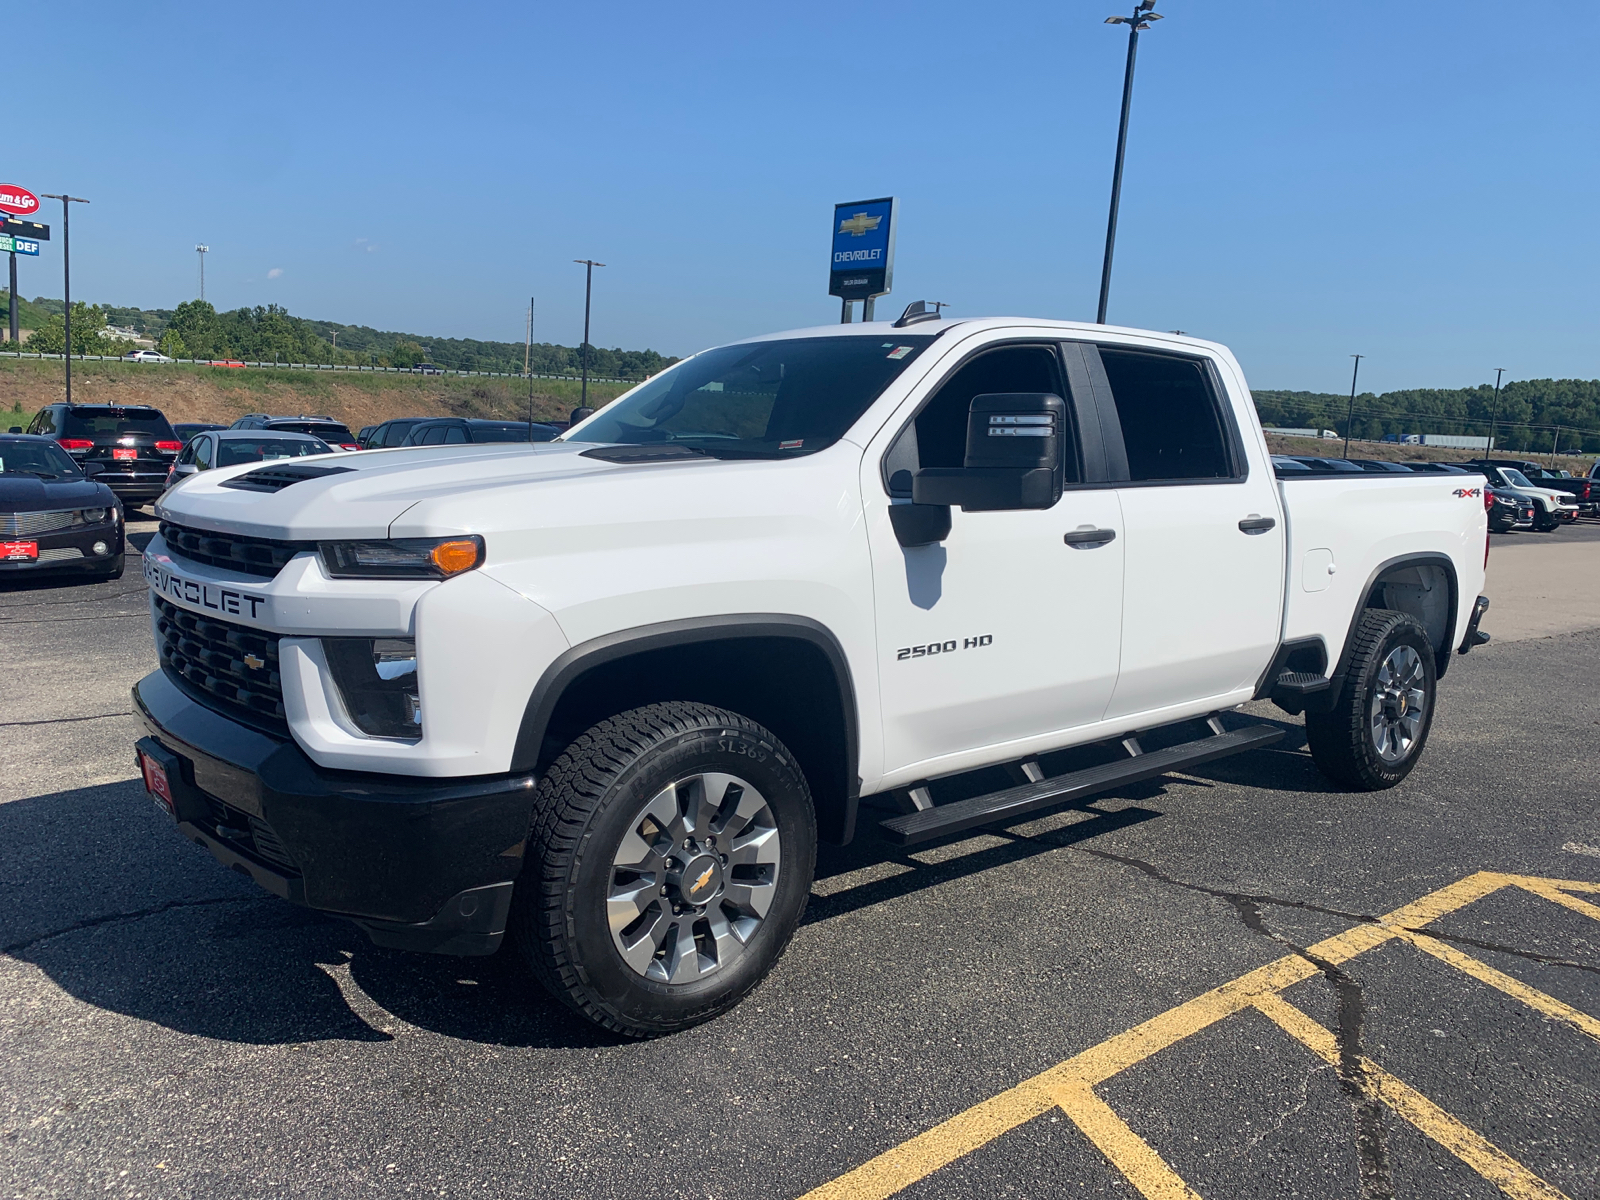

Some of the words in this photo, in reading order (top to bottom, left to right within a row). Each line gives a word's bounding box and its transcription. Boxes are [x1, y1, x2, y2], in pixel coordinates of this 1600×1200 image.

[21, 195, 35, 208] Go
[16, 241, 38, 252] DEF
[834, 248, 882, 263] CHEVROLET
[142, 559, 265, 619] CHEVROLET
[896, 639, 957, 661] 2500
[963, 634, 993, 650] HD
[628, 741, 710, 799] RADIAL
[717, 739, 767, 763] SL369
